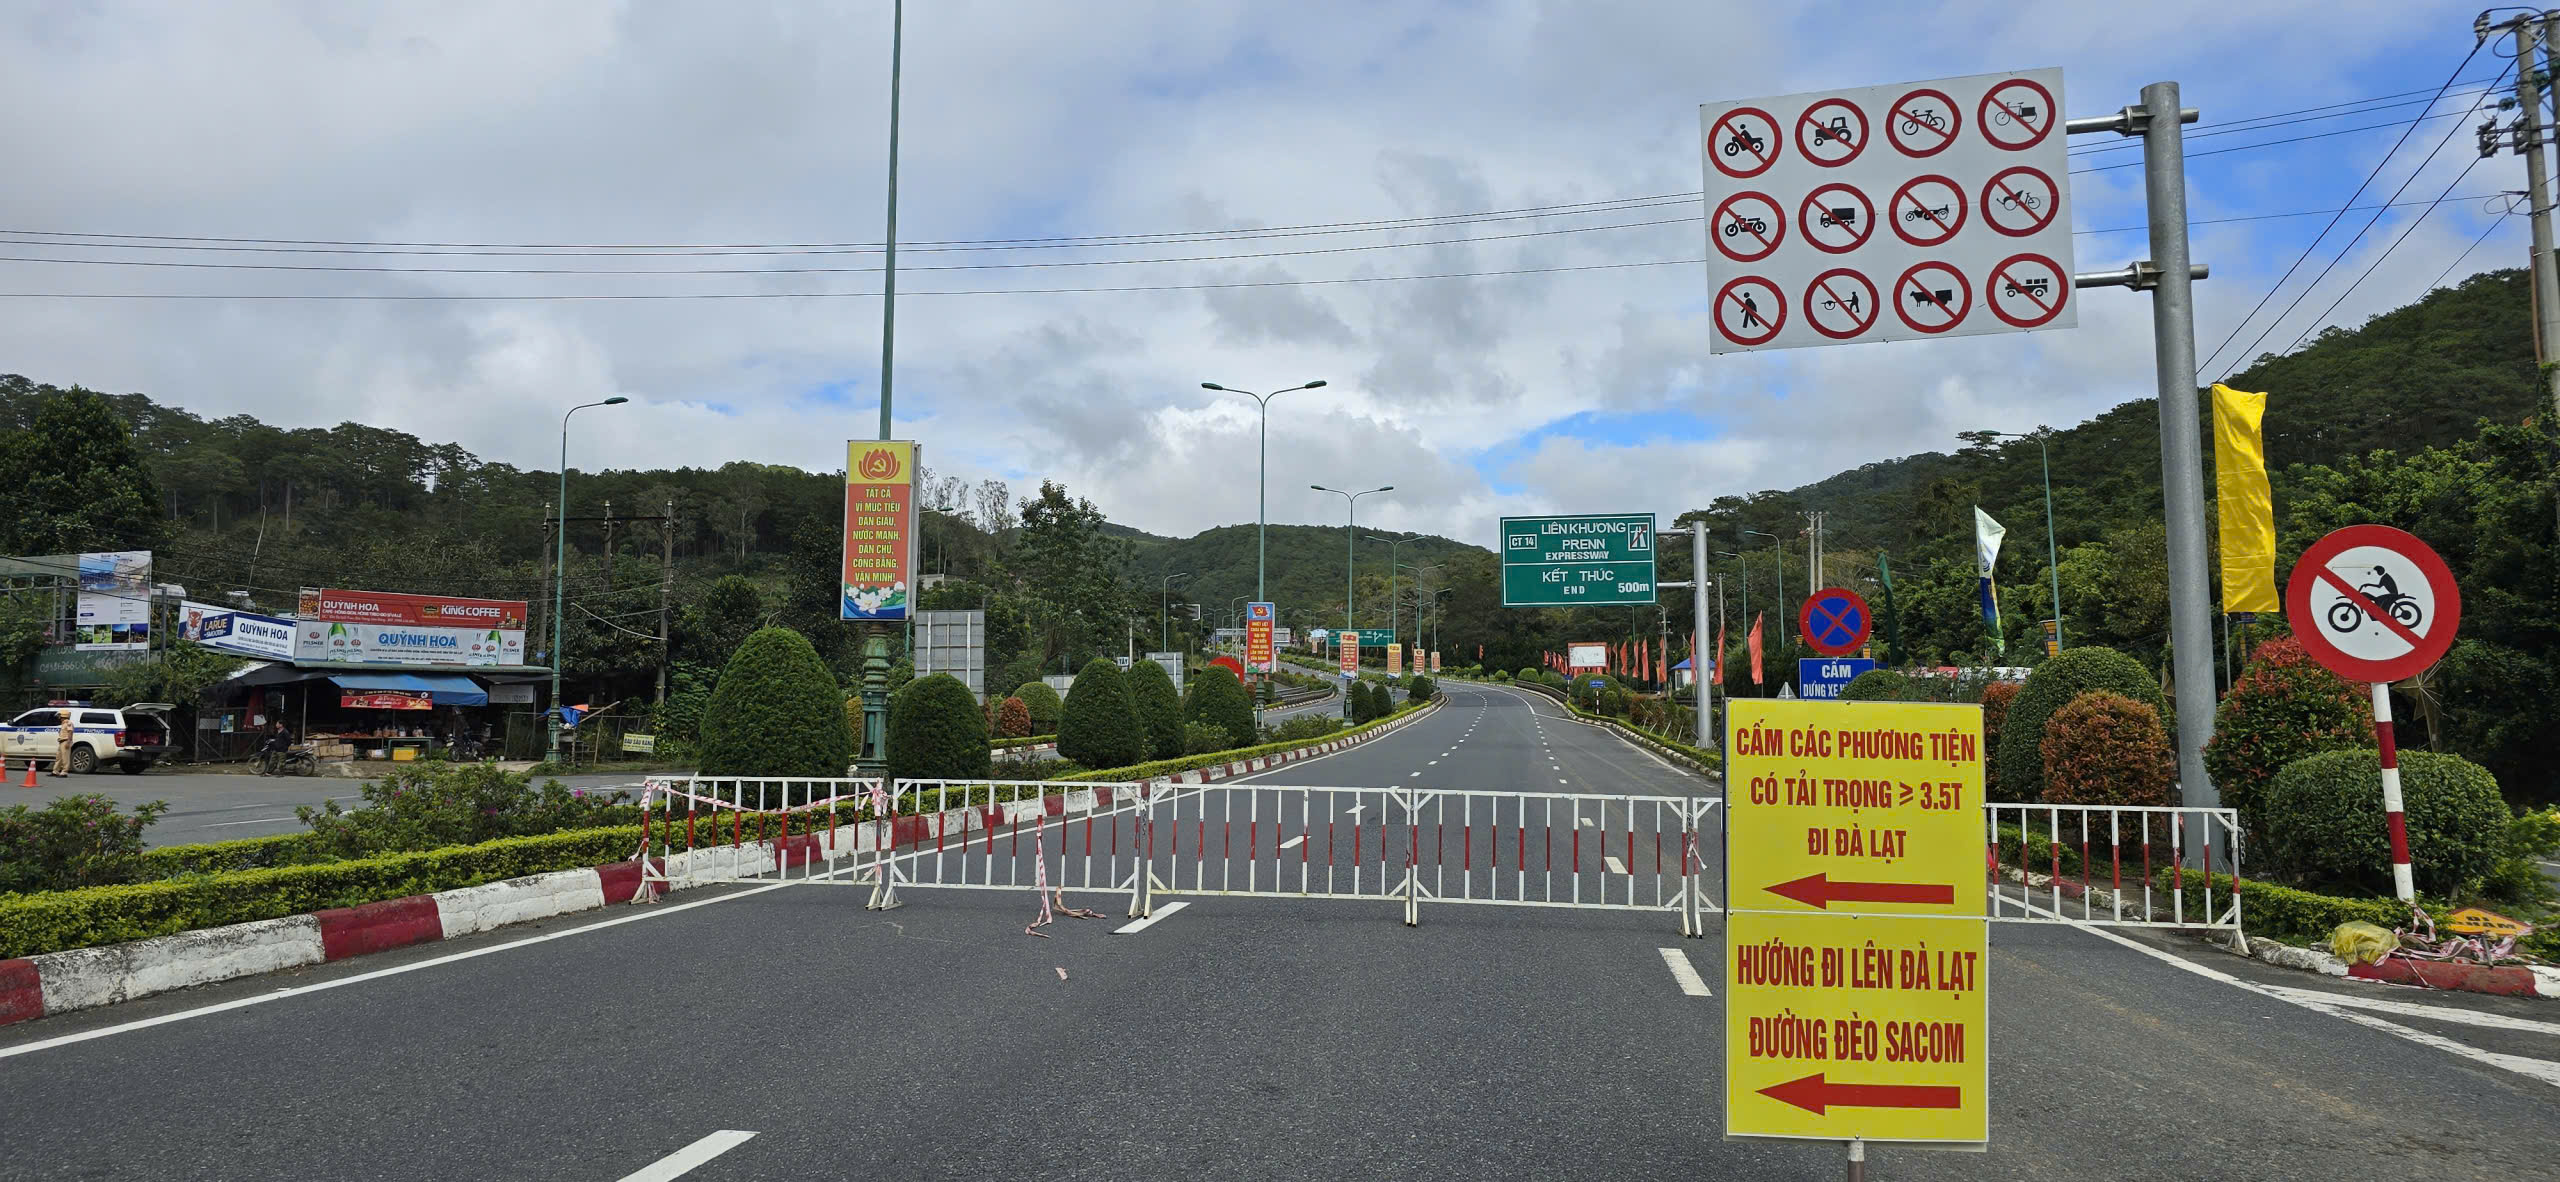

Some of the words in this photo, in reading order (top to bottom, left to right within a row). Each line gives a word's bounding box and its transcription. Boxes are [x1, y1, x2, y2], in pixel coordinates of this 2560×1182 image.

[866, 486, 878, 498] TẤT
[880, 486, 891, 498] CẢ
[856, 501, 863, 512] VÌ
[864, 502, 882, 514] MỤC
[884, 501, 900, 512] TIÊU
[858, 514, 874, 526] DÂN
[876, 514, 896, 527] GIÀU,
[1541, 521, 1569, 534] LIÊN
[1570, 522, 1626, 534] KHƯƠNG
[852, 528, 874, 540] NƯỚC
[876, 530, 900, 542] MẠNH,
[1512, 537, 1522, 546] CT
[1525, 536, 1534, 546] 14
[858, 543, 874, 554] DÂN
[876, 542, 894, 554] CHỦ,
[1562, 539, 1605, 550] PRENN
[852, 557, 874, 568] CÔNG
[876, 554, 898, 568] BẰNG,
[1545, 551, 1609, 560] EXPRESSWAY
[854, 571, 870, 582] VĂN
[872, 572, 896, 582] MINH!
[1542, 568, 1568, 582] KẾT
[1579, 568, 1614, 581] THÚC
[1564, 586, 1586, 594] END
[1618, 582, 1650, 593] 500m
[323, 600, 358, 610] QUỲNH
[359, 603, 379, 612] HOA
[442, 604, 464, 616] KING
[466, 607, 500, 618] COFFEE
[205, 618, 228, 632] LARUE
[240, 622, 268, 637] QUỲNH
[270, 628, 288, 640] HOA
[378, 631, 426, 647] QUỲNH
[430, 636, 457, 648] HOA
[1822, 659, 1851, 678] CẤM
[1803, 680, 1826, 697] DỪNG
[1828, 684, 1838, 697] XE
[1737, 719, 1782, 755] CẤM
[1791, 724, 1830, 757] CÁC
[1839, 729, 1923, 760] PHƯƠNG
[1930, 728, 1976, 767] TIỆN
[1751, 777, 1777, 804] CÓ
[1785, 769, 1816, 806] TẢI
[1824, 780, 1891, 813] TRỌNG
[1921, 782, 1962, 810] 3.5T
[1808, 828, 1828, 856] ĐI
[1836, 823, 1862, 857] ĐÀ
[1871, 830, 1906, 863] LẠT
[1738, 937, 1813, 987] HƯỚNG
[1822, 949, 1843, 987] ĐI
[1852, 941, 1893, 989] LÊN
[1901, 942, 1930, 990] ĐÀ
[1938, 952, 1977, 1000] LẠT
[1750, 1008, 1827, 1059] ĐƯỜNG
[1835, 1011, 1877, 1061] ĐÈO
[1886, 1021, 1964, 1063] SACOM
